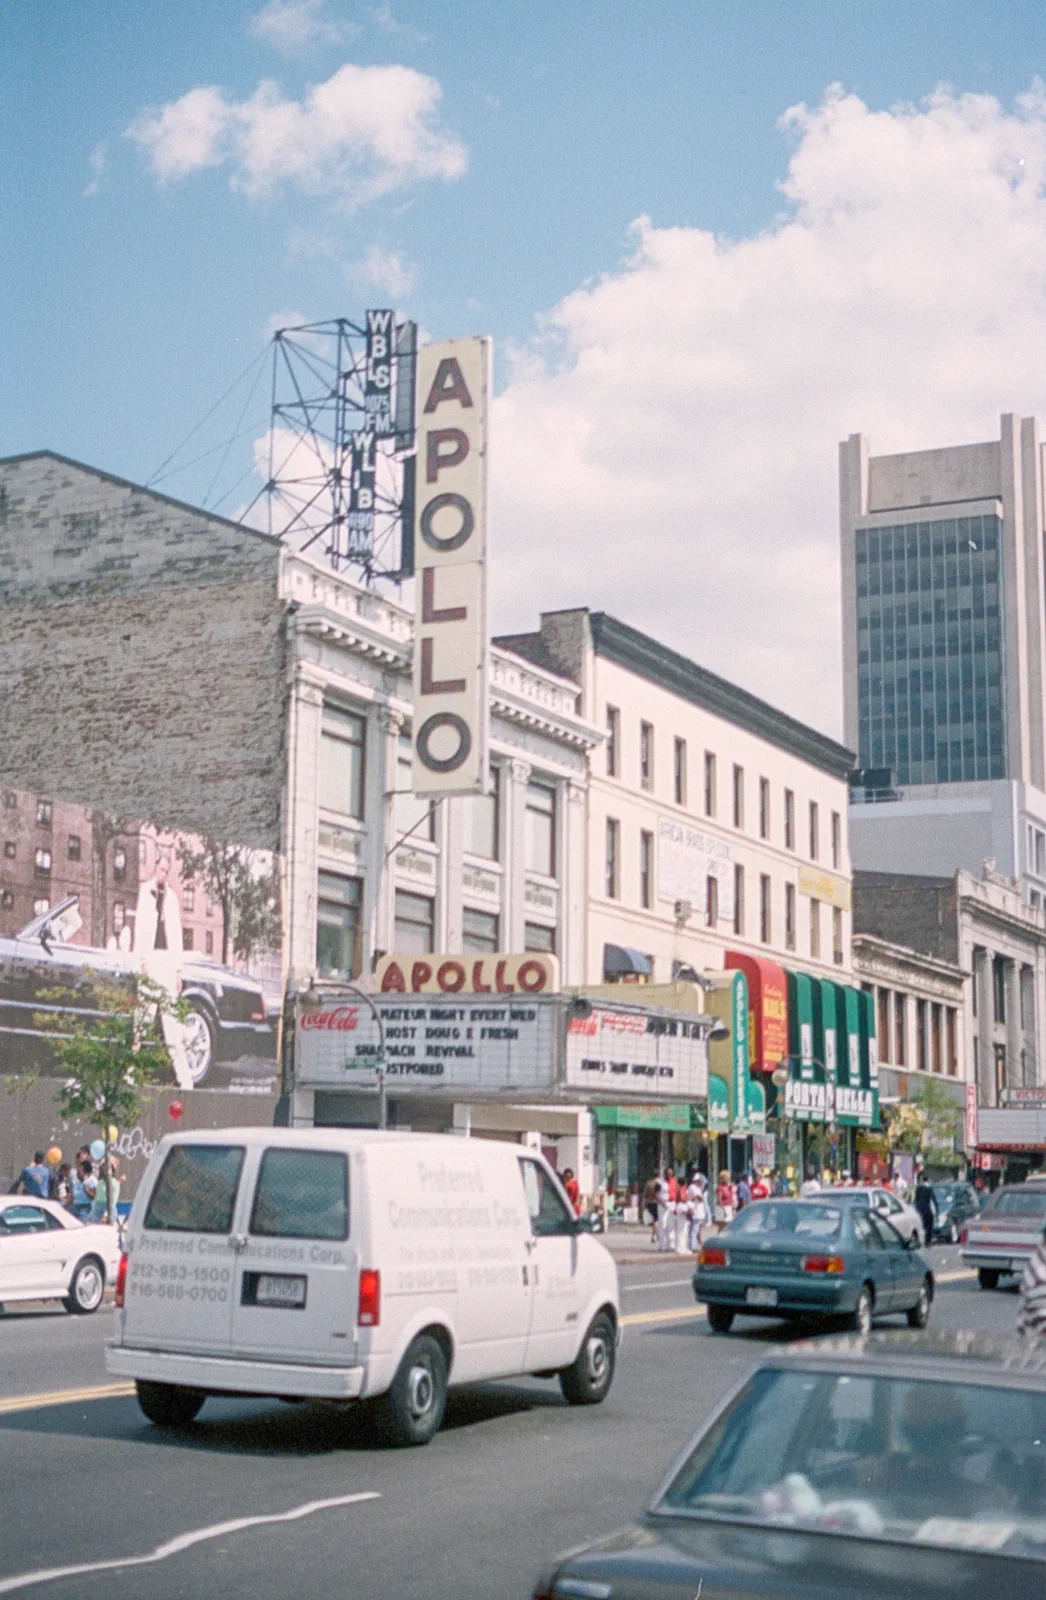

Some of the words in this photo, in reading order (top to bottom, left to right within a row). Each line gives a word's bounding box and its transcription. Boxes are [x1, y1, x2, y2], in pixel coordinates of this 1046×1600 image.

[416, 356, 476, 774] APOLLO
[380, 960, 548, 994] APOLLO
[469, 1008, 507, 1021] EVERY
[385, 1026, 417, 1039] HOST
[425, 1026, 461, 1039] DOUG
[480, 1027, 518, 1040] FRESH
[138, 1234, 195, 1254] Preferred
[198, 1238, 304, 1261] Commnications
